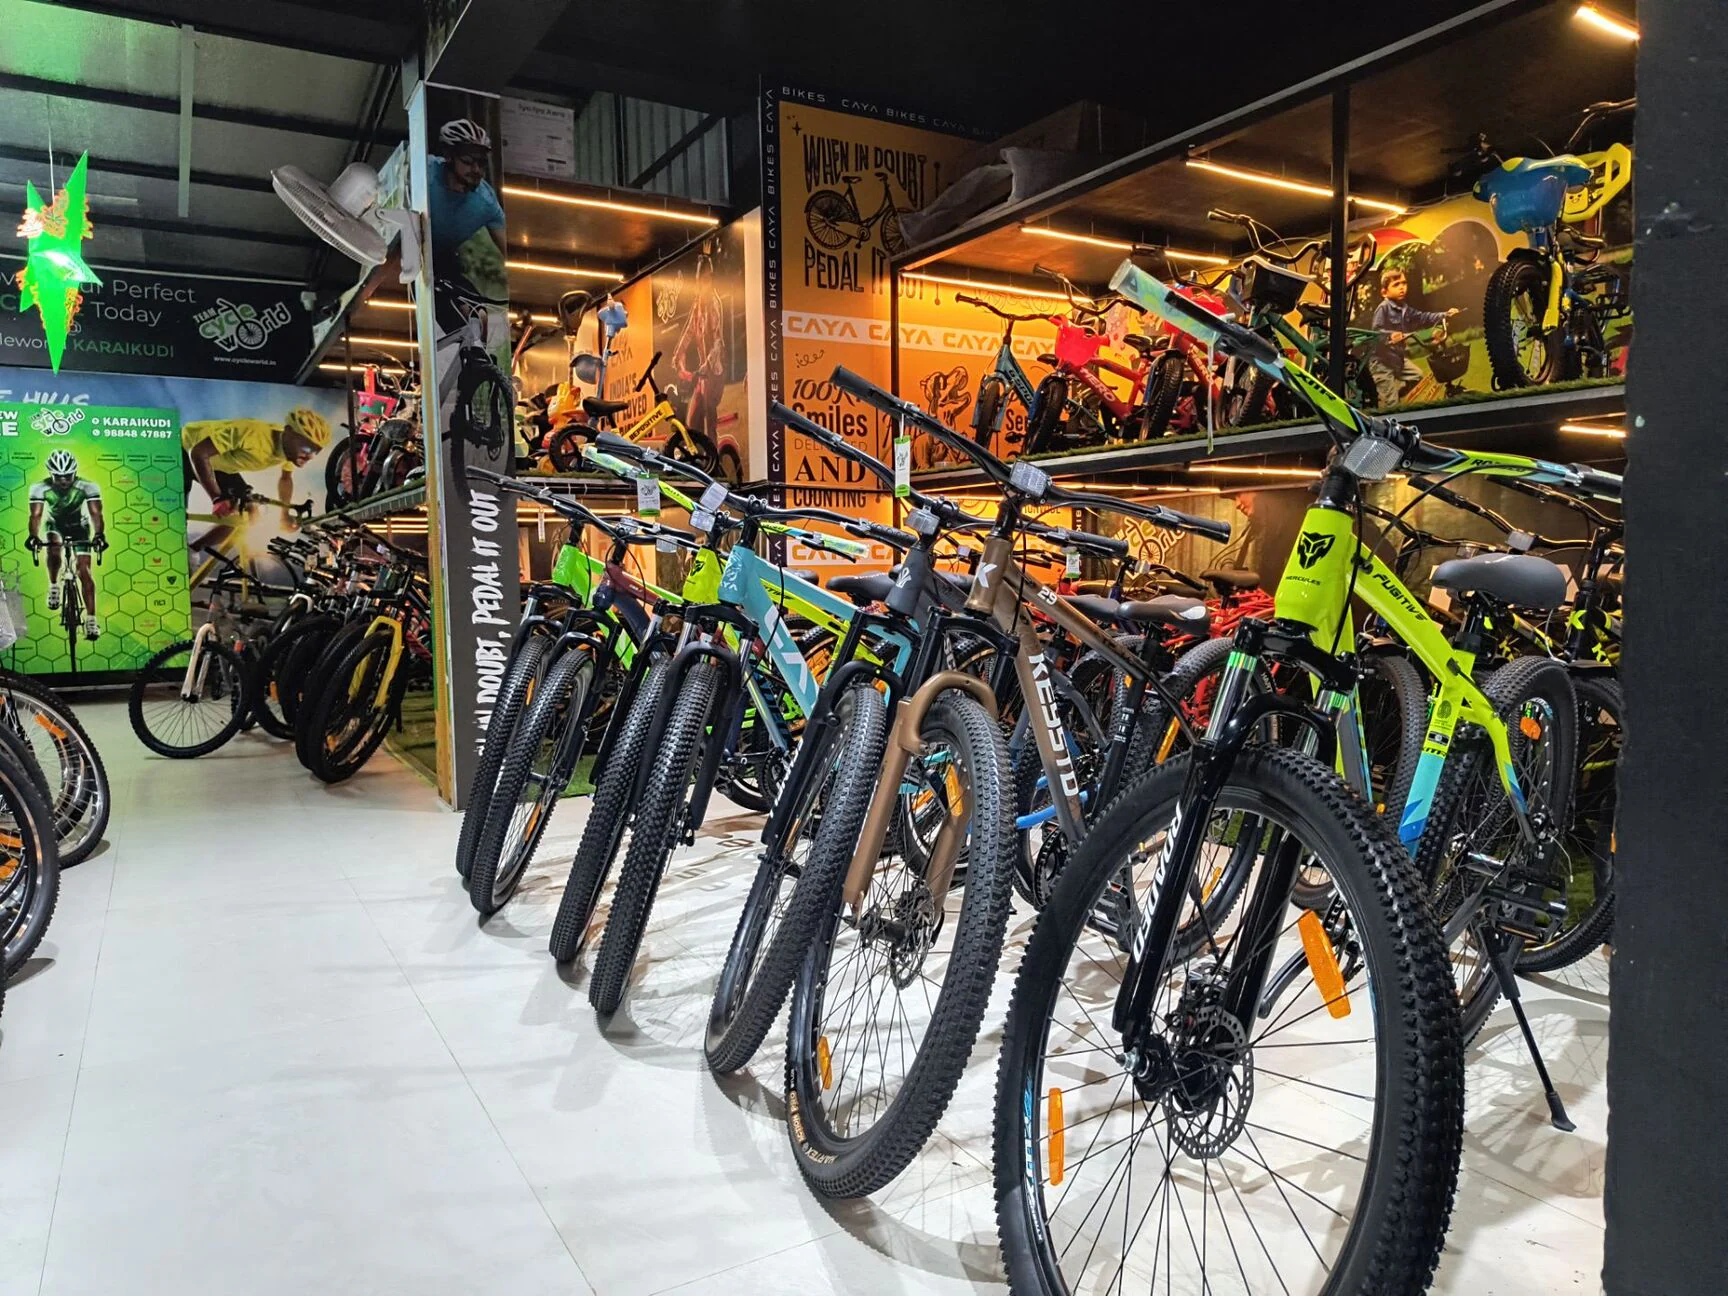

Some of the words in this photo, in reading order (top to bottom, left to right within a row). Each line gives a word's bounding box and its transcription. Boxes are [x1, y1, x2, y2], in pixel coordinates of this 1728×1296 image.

[782, 86, 827, 103] BIKES
[803, 133, 849, 192] WHEN
[855, 143, 869, 172] IN
[874, 147, 927, 209] DOUBT
[769, 258, 777, 310] BIKES
[804, 236, 865, 293] PEDAL
[112, 279, 197, 304] Perfect
[91, 301, 162, 326] Today
[73, 339, 175, 358] KARAIKUDI
[770, 319, 778, 361] CAYA
[787, 316, 858, 338] CAYA
[868, 324, 933, 347] CAYA
[1012, 338, 1056, 357] CAY
[103, 417, 171, 428] KARAIKUDI
[795, 455, 867, 483] AND
[469, 488, 501, 533] OUT
[471, 536, 503, 558] IT
[469, 561, 512, 625] PEDAL
[1372, 571, 1429, 623] FUGITIVE
